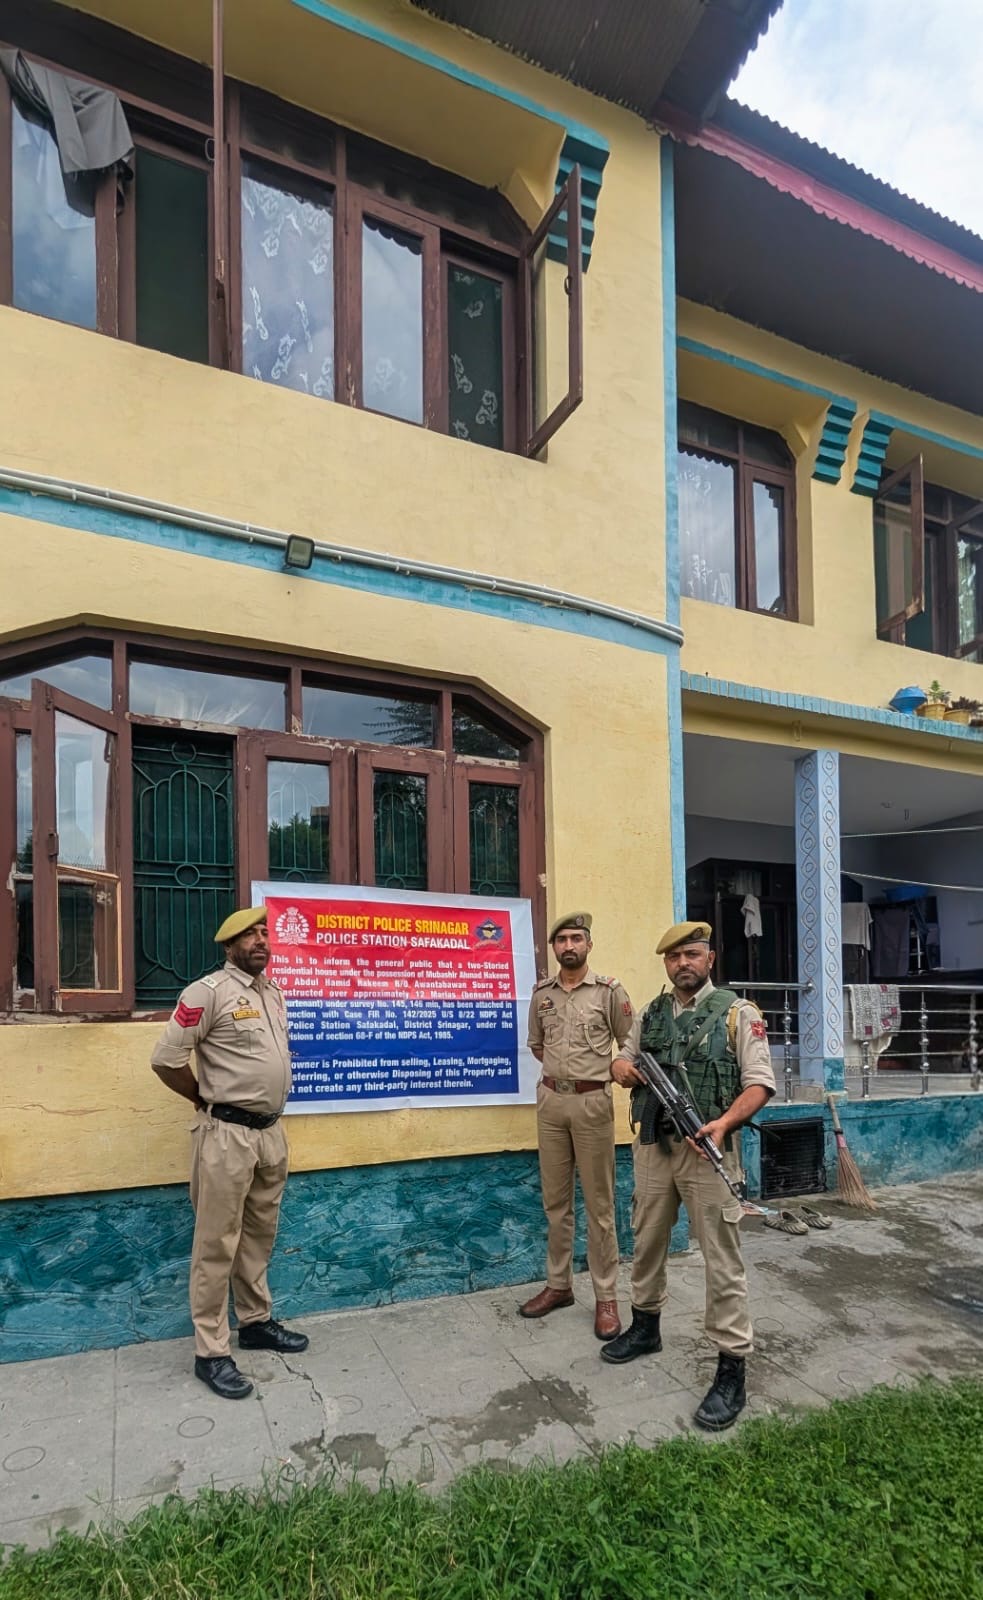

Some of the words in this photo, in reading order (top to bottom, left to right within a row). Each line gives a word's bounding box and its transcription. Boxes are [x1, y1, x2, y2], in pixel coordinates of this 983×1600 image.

[316, 914, 369, 929] DISTRICT
[373, 917, 412, 932] POLICE
[415, 920, 469, 935] SRINAGAR
[316, 932, 358, 944] POLICE
[272, 955, 289, 963] This
[296, 956, 303, 964] is
[324, 957, 350, 965] inform
[410, 960, 432, 970] public
[272, 967, 312, 975] residential
[340, 968, 361, 976] under
[498, 982, 510, 990] Sgr
[354, 990, 409, 999] approximately
[285, 1000, 322, 1008] urtenant)
[350, 1001, 374, 1009] survey
[438, 1021, 470, 1030] Srinagar,
[419, 1031, 432, 1040] Act,
[291, 1061, 320, 1069] owner
[322, 1059, 330, 1068] is
[333, 1058, 377, 1067] Prohibited
[380, 1058, 399, 1066] from
[401, 1058, 431, 1067] selling,
[433, 1058, 465, 1066] Leasing,
[467, 1057, 511, 1066] Mortgaging,
[292, 1072, 330, 1082] sferring,
[392, 1069, 431, 1078] Disposing
[435, 1069, 442, 1077] of
[446, 1068, 460, 1076] this
[463, 1068, 495, 1077] Property
[298, 1084, 312, 1093] not
[315, 1083, 344, 1092] create
[346, 1084, 361, 1093] any
[364, 1082, 408, 1091] third-party
[410, 1080, 442, 1088] interest
[444, 1079, 473, 1087] therein.
